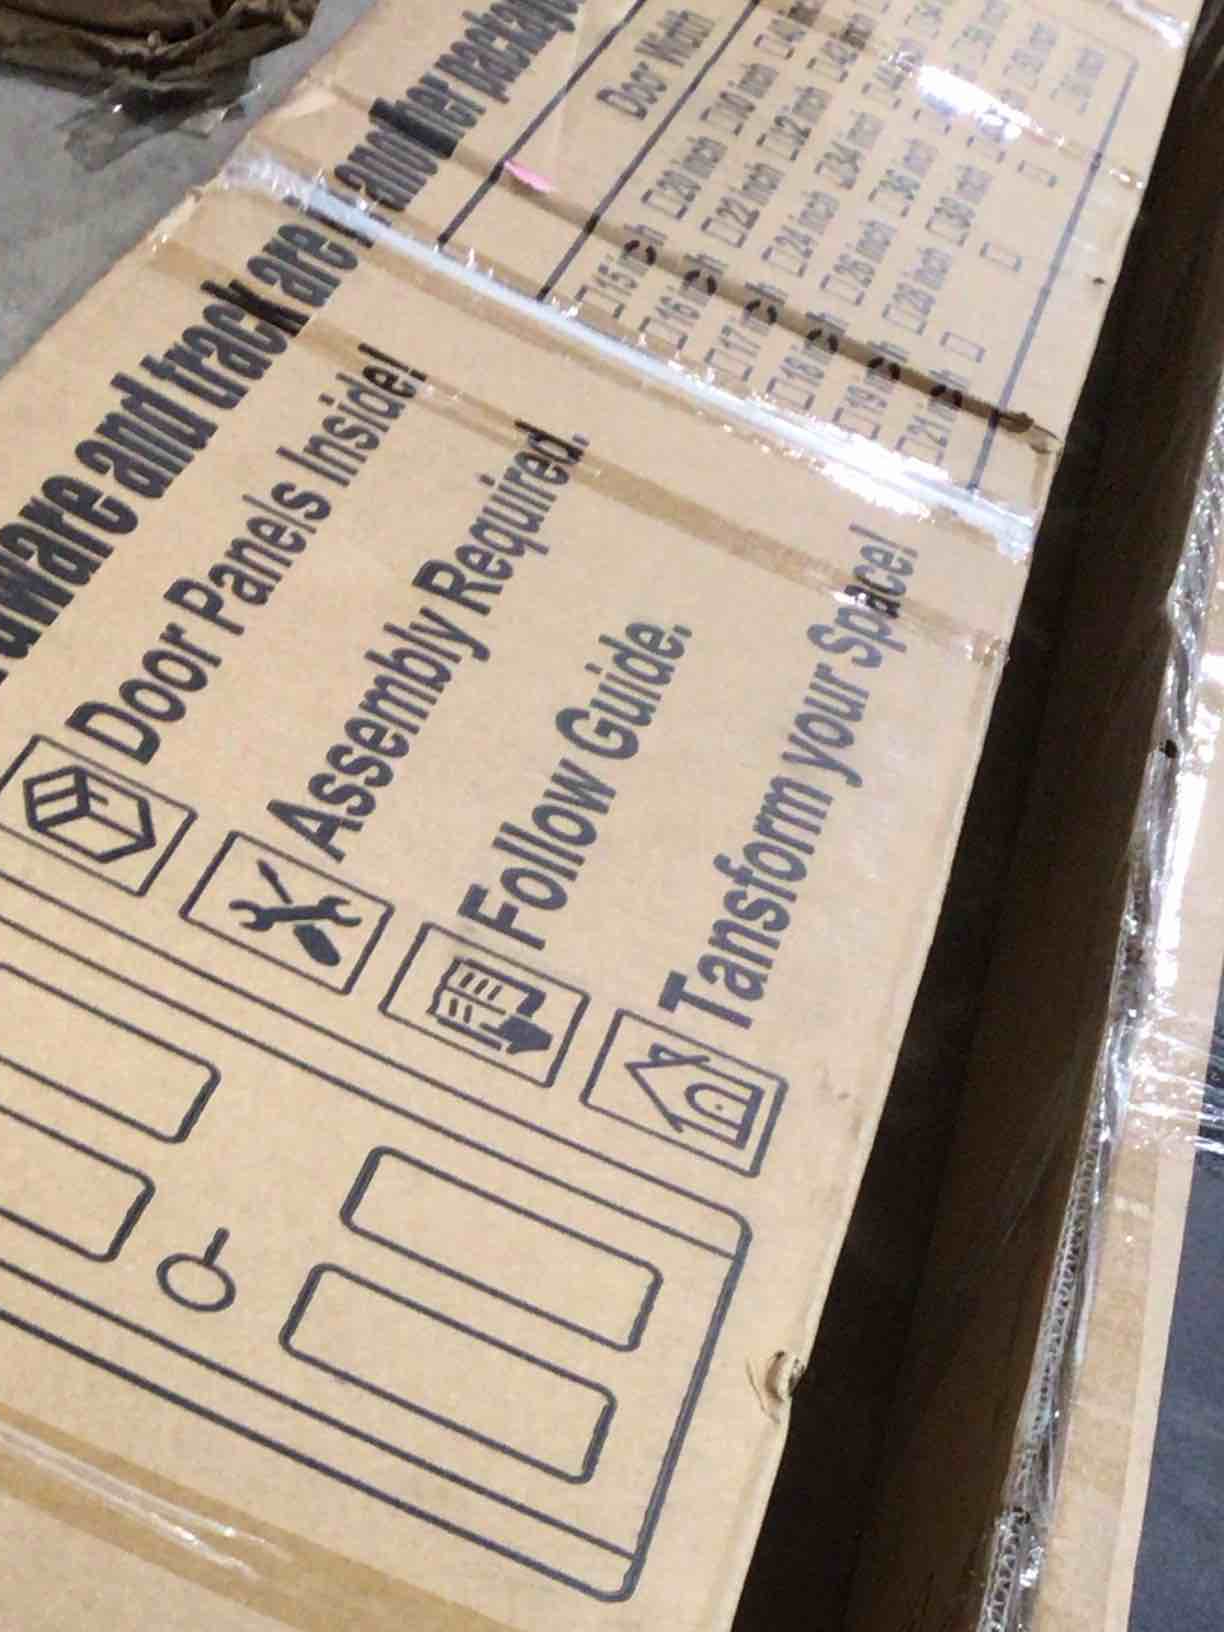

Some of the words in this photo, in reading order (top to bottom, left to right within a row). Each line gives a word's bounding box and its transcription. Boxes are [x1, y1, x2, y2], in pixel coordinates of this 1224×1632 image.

[333, 72, 487, 211] another
[246, 223, 359, 308] are
[715, 196, 761, 230] 22
[139, 278, 313, 410] track
[74, 372, 219, 499] and
[64, 622, 223, 765] Door
[163, 481, 332, 636] Panels
[276, 342, 428, 488] Inside!
[806, 521, 919, 669] Space!
[266, 606, 492, 863] Assembly
[412, 419, 591, 616] Required.
[457, 757, 618, 951] Follow
[554, 621, 693, 760] Guide.
[781, 663, 871, 789] your
[657, 775, 836, 1030] Tansform
